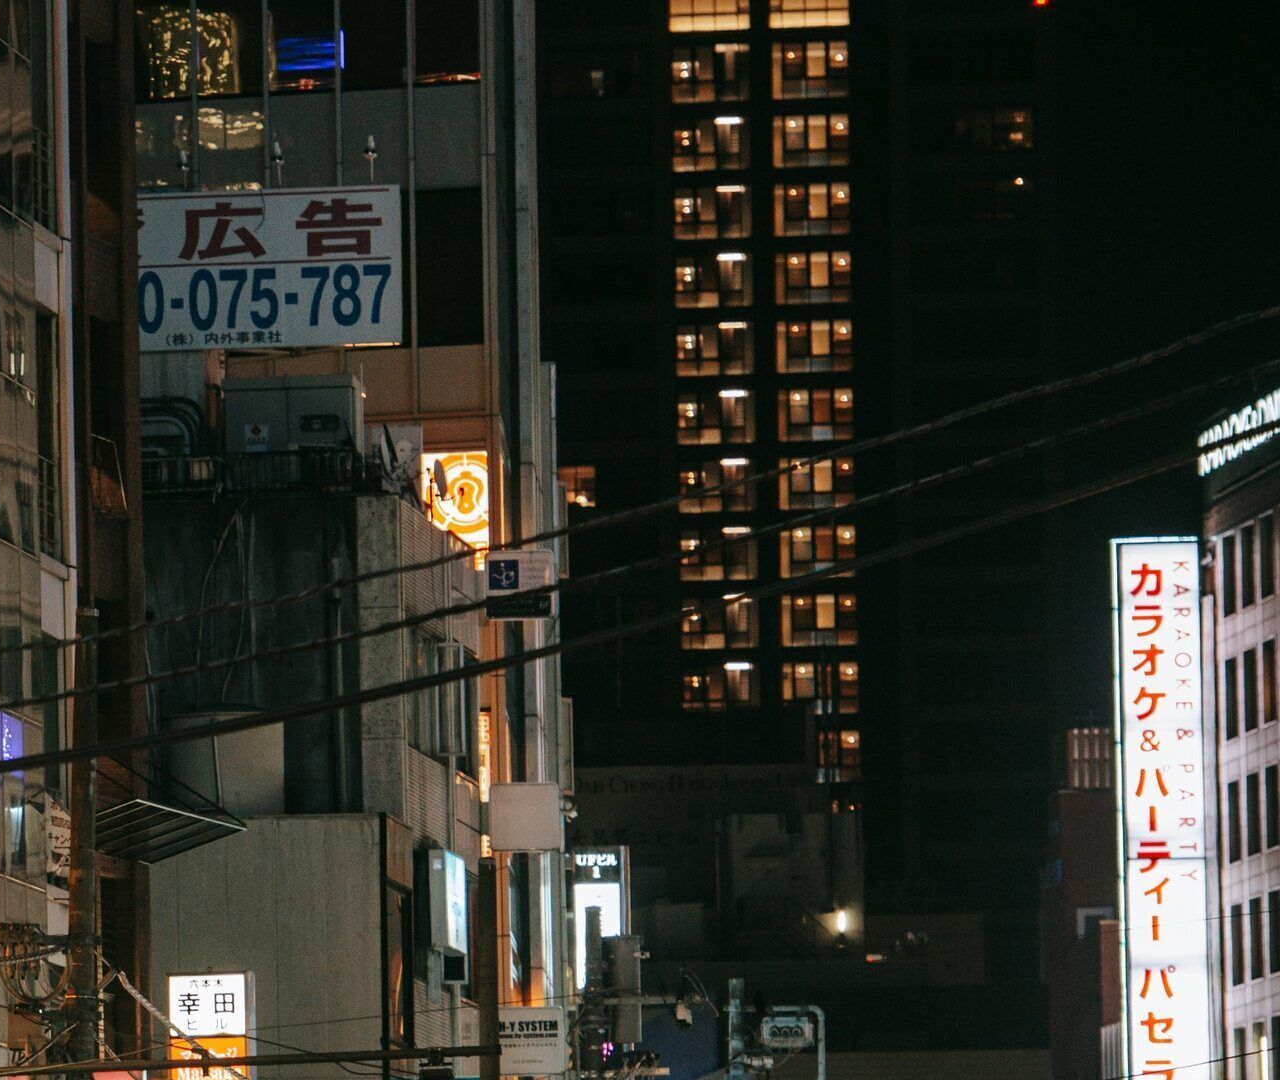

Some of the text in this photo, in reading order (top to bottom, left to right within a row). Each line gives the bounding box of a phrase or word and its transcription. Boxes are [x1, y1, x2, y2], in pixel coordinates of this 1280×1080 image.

[137, 199, 382, 261] 広告
[189, 979, 224, 988] 六本木
[178, 992, 235, 1016] 幸田
[518, 1021, 558, 1032] SYSTEM
